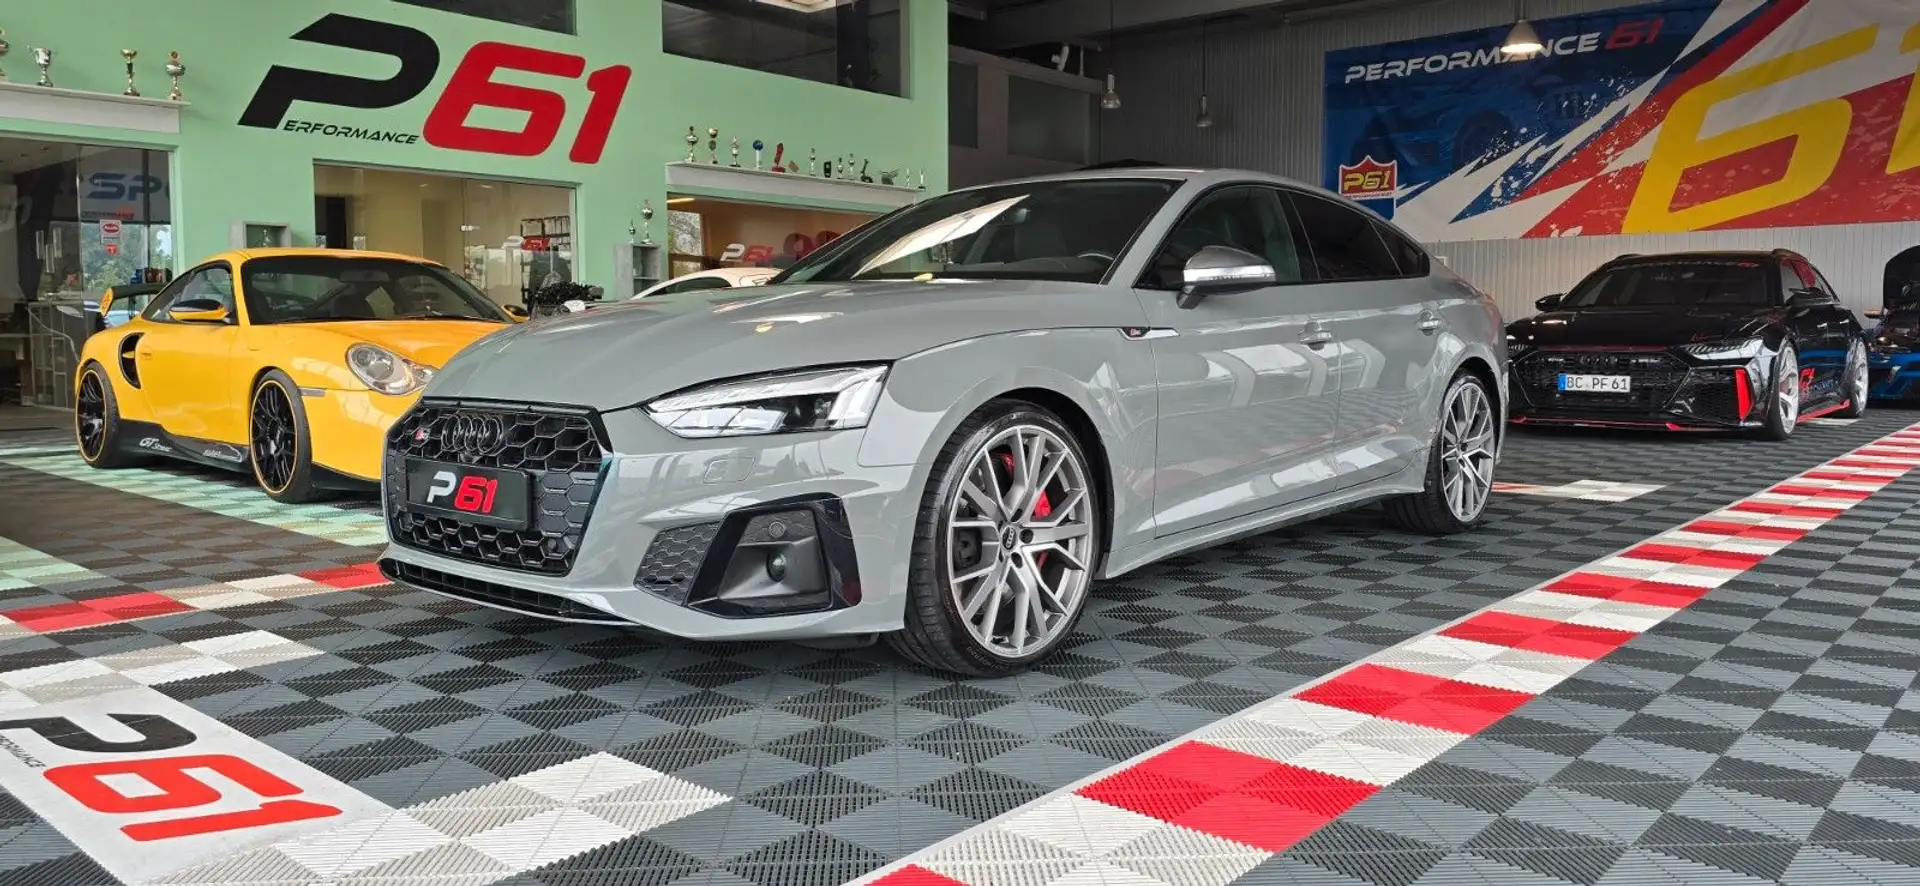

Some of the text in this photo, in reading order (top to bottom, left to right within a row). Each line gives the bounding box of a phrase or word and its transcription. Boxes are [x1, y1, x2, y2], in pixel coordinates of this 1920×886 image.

[1604, 18, 1664, 50] 61
[237, 12, 632, 165] P61
[1343, 170, 1391, 191] P61
[1566, 376, 1628, 391] BC PF 61
[426, 470, 498, 514] P61
